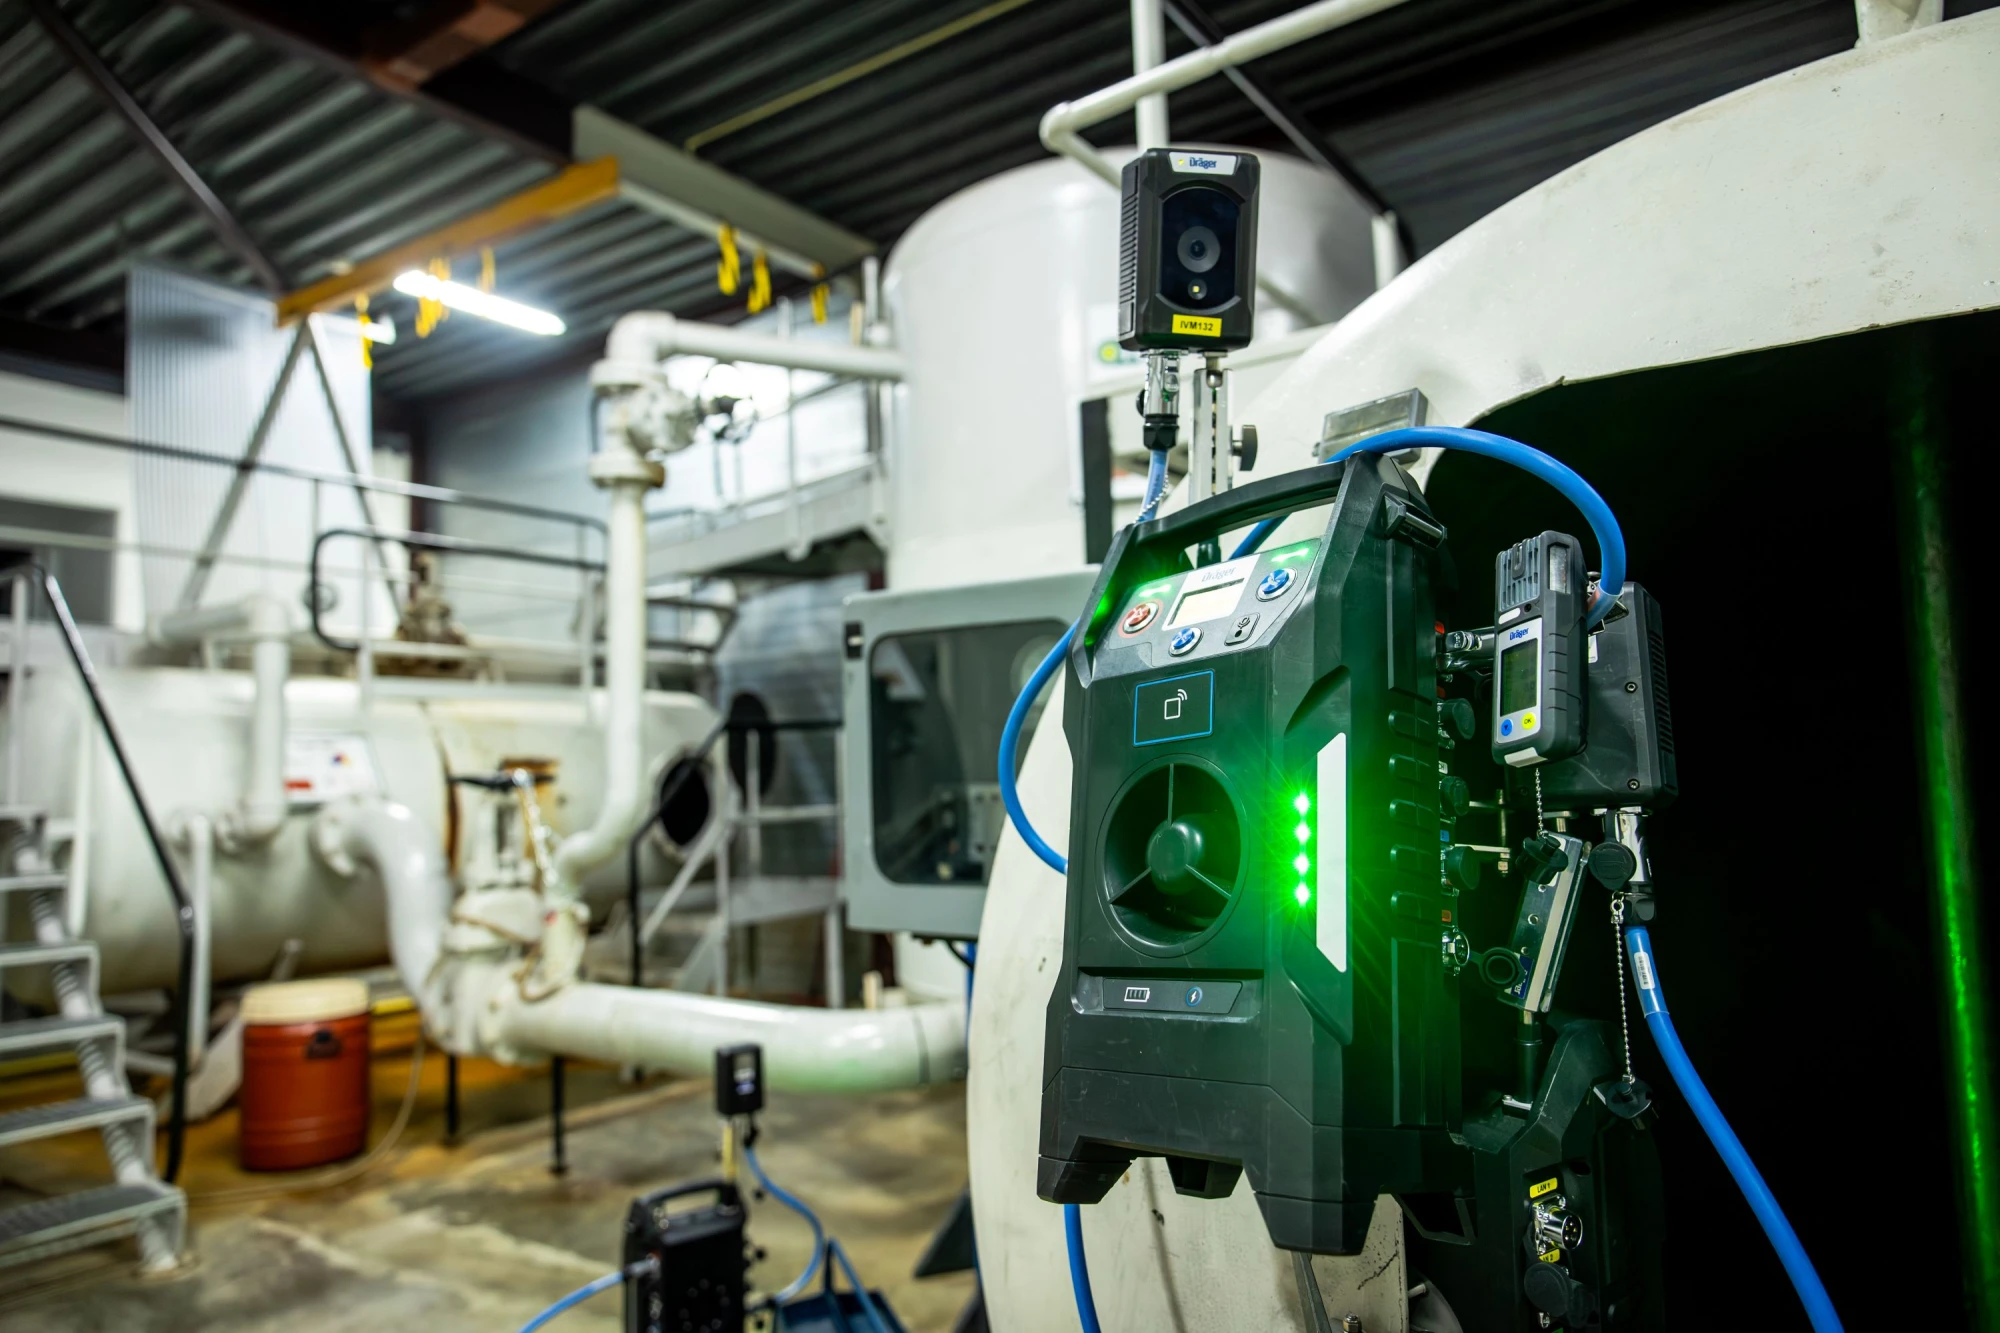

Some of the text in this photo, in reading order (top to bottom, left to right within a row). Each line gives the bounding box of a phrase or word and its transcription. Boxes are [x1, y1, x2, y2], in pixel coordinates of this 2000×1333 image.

[1189, 157, 1217, 169] Dräger
[1180, 320, 1214, 331] IVM132
[1510, 628, 1529, 640] Dräger
[1537, 1183, 1547, 1193] LAN
